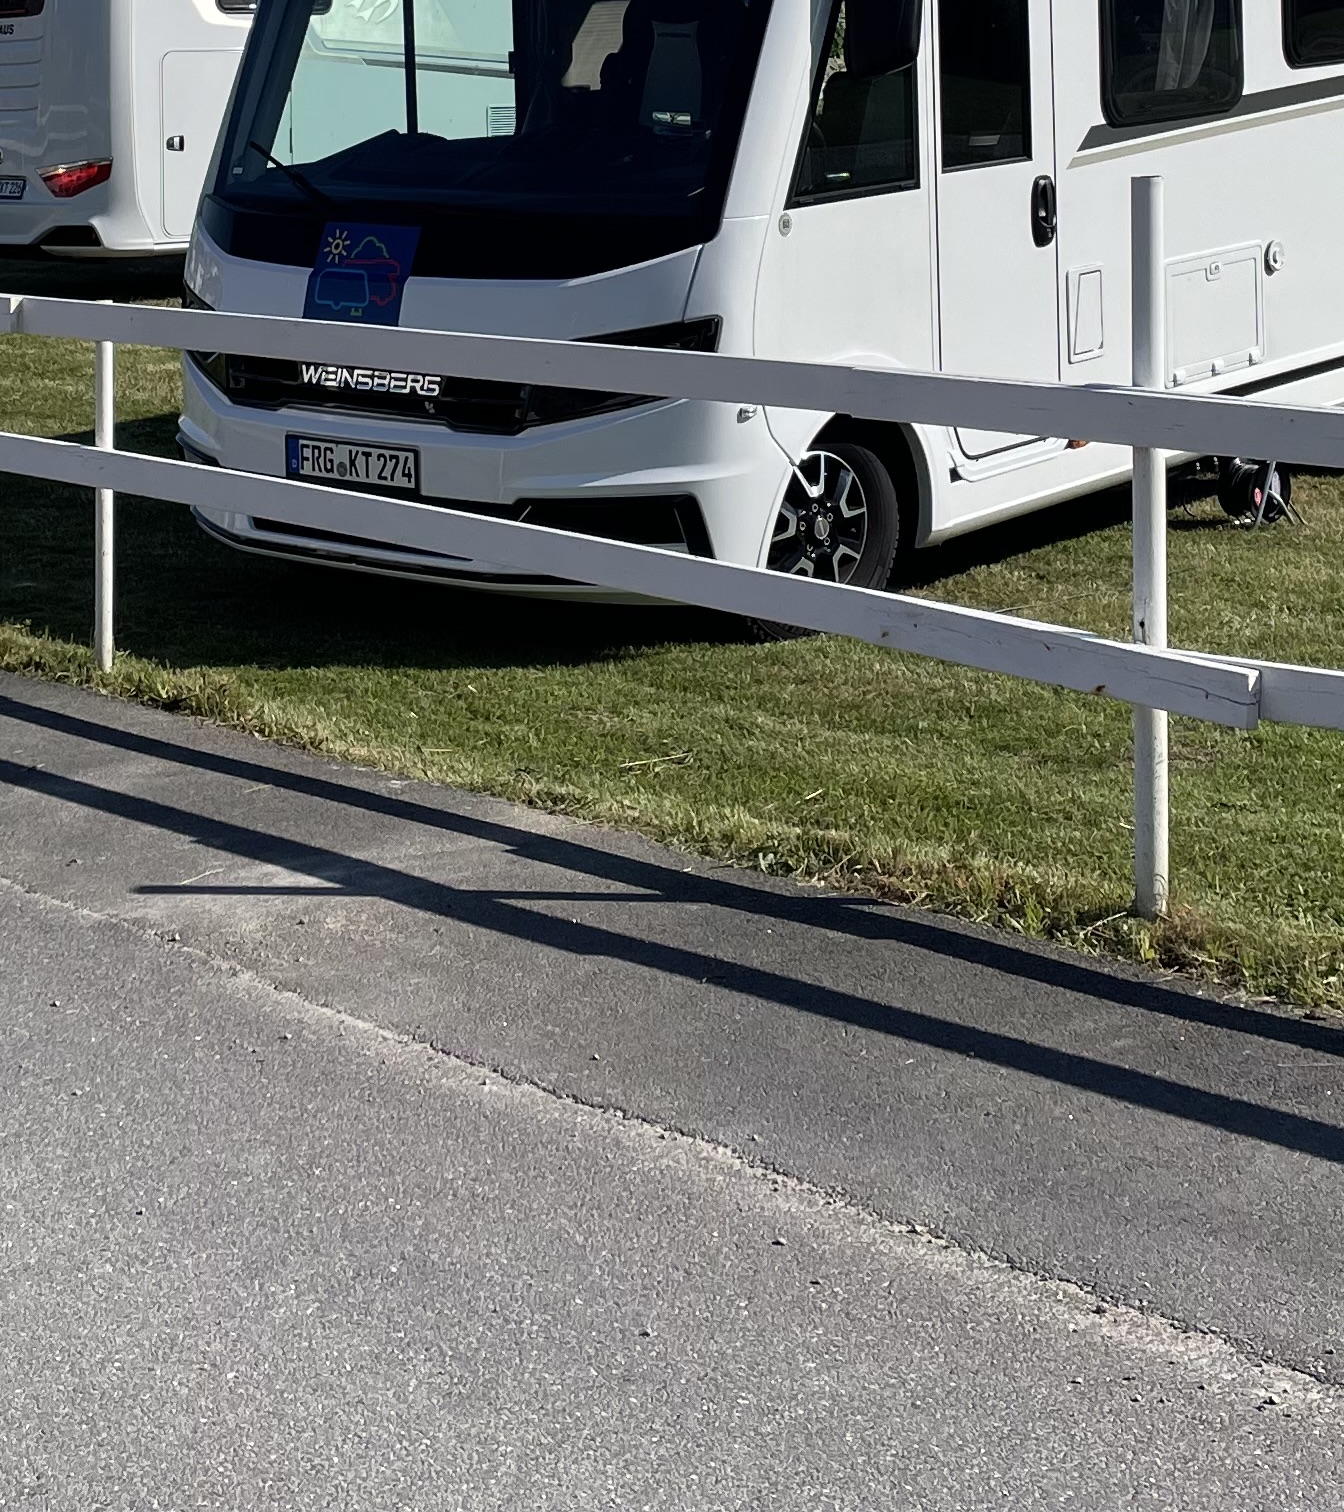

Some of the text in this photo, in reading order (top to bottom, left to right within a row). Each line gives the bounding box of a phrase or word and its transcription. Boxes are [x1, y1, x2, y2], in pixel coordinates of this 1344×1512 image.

[301, 363, 442, 397] WEINSBERG
[299, 442, 335, 474] FRG
[376, 451, 413, 484] 274
